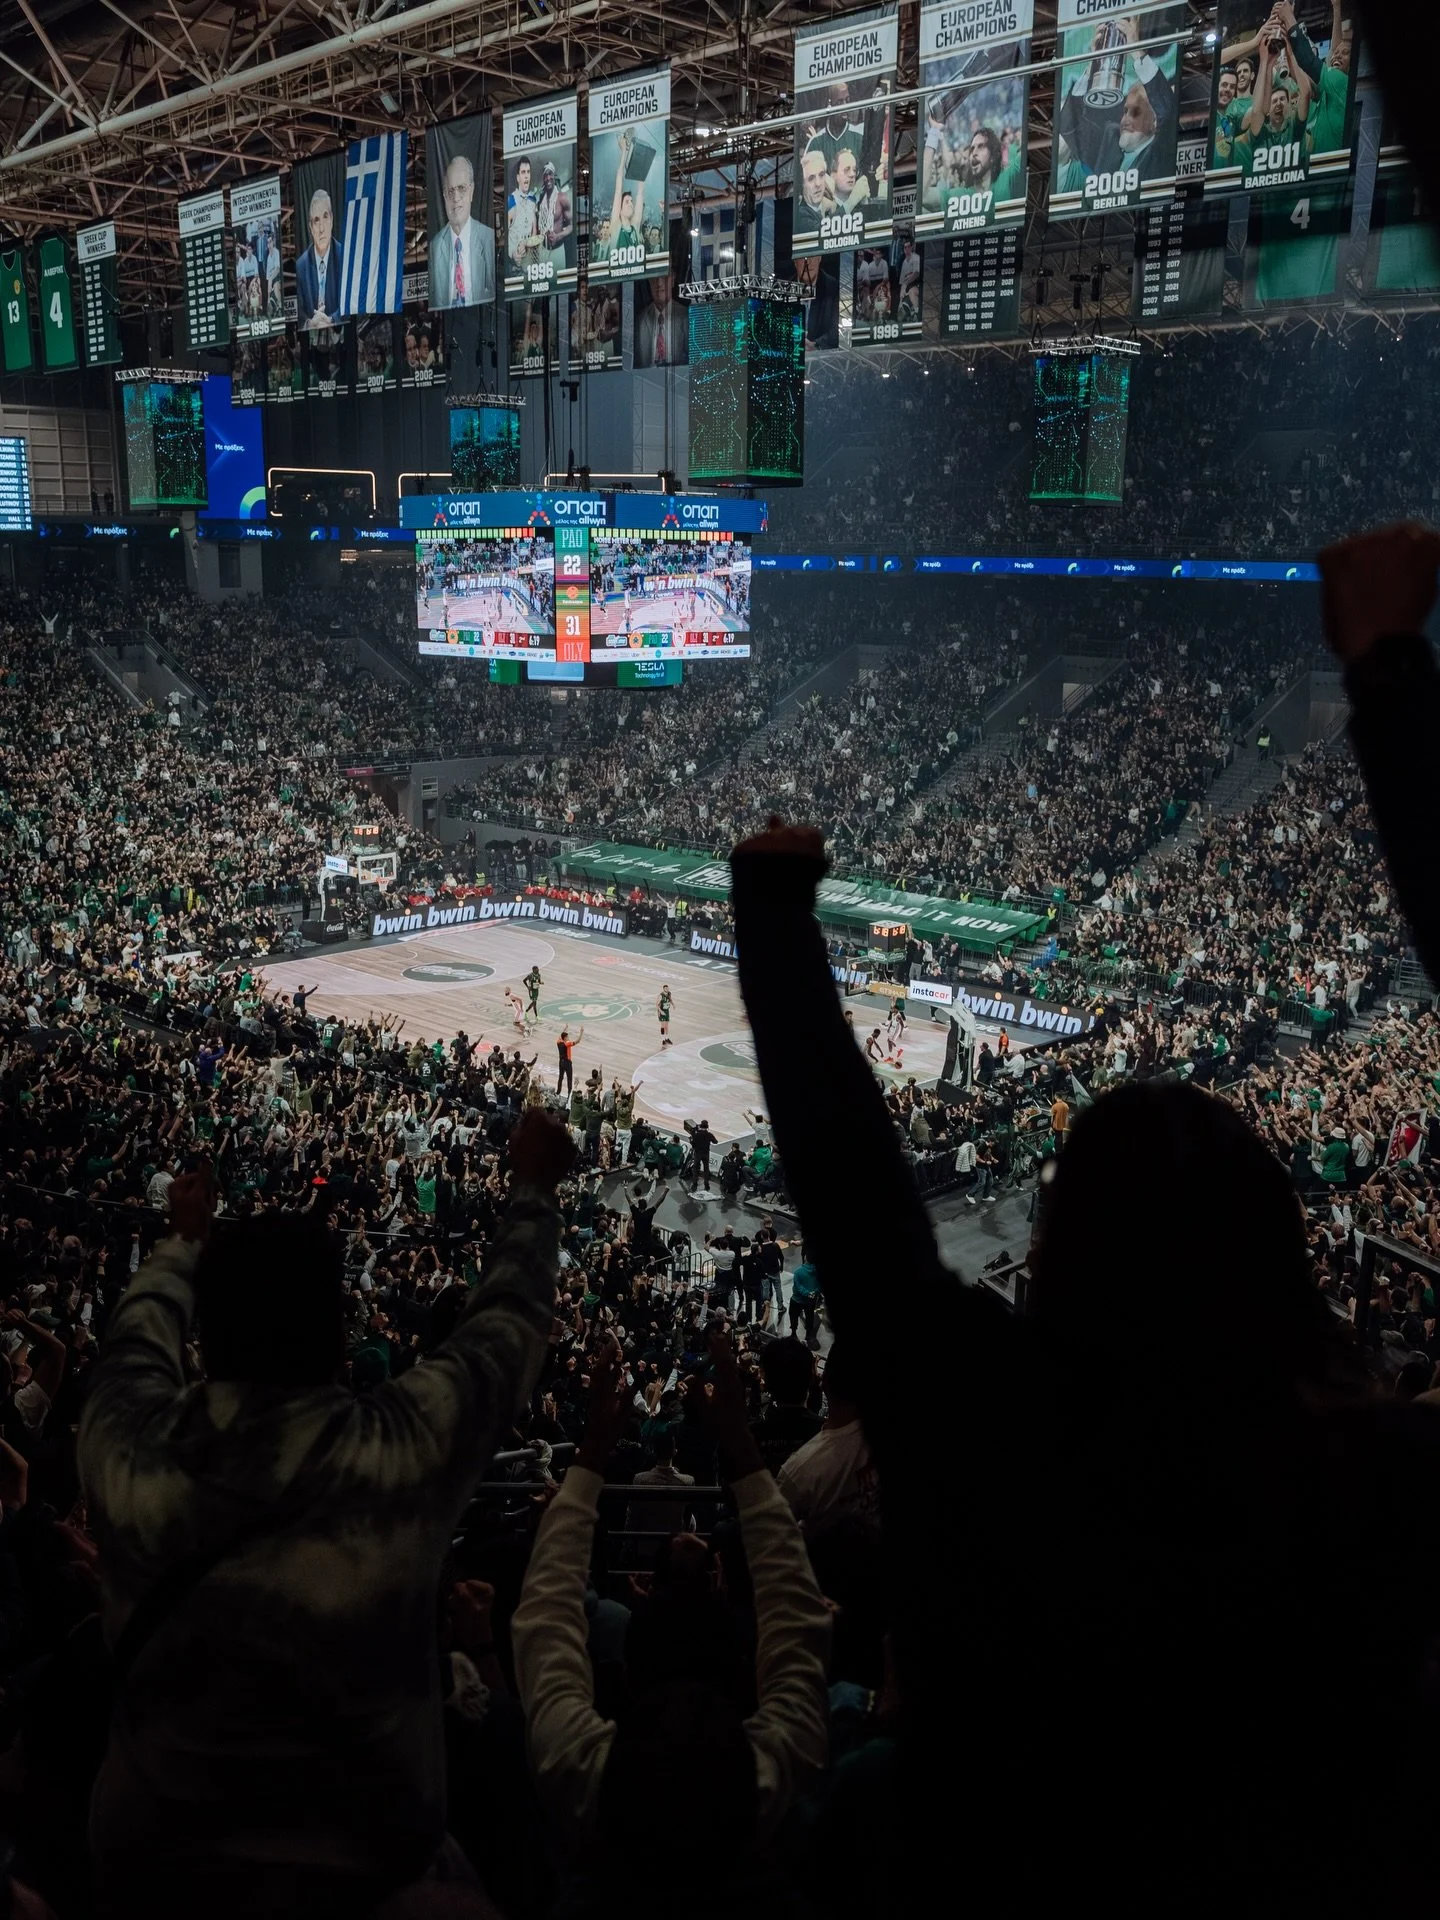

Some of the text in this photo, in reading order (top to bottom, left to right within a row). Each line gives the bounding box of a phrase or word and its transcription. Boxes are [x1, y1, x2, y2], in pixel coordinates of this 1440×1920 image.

[940, 0, 1012, 30] EUROPEAN
[935, 14, 1017, 49] CHAMPIONS
[814, 32, 878, 61] EUROPEAN
[809, 48, 882, 79] CHAMPIONS
[604, 85, 655, 109] EUROPEAN
[600, 99, 658, 124] CHAMPIONS
[516, 109, 563, 132] EUROPEAN
[513, 124, 566, 147] CHAMPIONS
[1253, 141, 1301, 172] 2011
[1084, 169, 1139, 197] 2009
[1244, 169, 1306, 189] BARCELONA
[233, 187, 278, 207] INTERCONTINENTAL
[947, 190, 992, 218] 2007
[1093, 195, 1128, 211] BERLIN
[193, 200, 222, 217] CHAMPIONSHIP
[238, 199, 272, 216] CUP WINNERS
[1290, 198, 1310, 230] 4
[193, 214, 211, 225] WINNERS
[820, 212, 864, 235] 2002
[952, 216, 986, 232] ATHENS
[84, 231, 107, 245] GREEK CUP
[824, 234, 859, 250] BOLOGNA
[610, 245, 645, 266] 2000
[526, 262, 554, 282] 1996
[531, 282, 549, 293] PARIS
[1165, 283, 1179, 291] 2021
[1163, 294, 1179, 303] 2025
[8, 300, 20, 324] 13
[50, 291, 63, 328] 4
[251, 320, 270, 336] 1996
[873, 323, 899, 340] 1996
[523, 355, 544, 369] 2000
[585, 351, 605, 364] 1996
[367, 375, 384, 386] 2007
[414, 370, 433, 381] 2002
[240, 389, 256, 400] 2024
[278, 386, 292, 396] 2011
[579, 516, 606, 526] allwyn
[699, 520, 719, 529] allwyn
[562, 529, 582, 548] PAO
[563, 555, 581, 575] 22
[566, 616, 580, 636] 31
[529, 635, 540, 646] 6:19
[662, 633, 668, 643] 22
[723, 634, 734, 643] 6:19
[563, 642, 584, 661] OLY
[635, 662, 664, 671] TESLA
[922, 910, 952, 921] IT
[951, 916, 1016, 933] NOW
[912, 986, 949, 999] instacar
